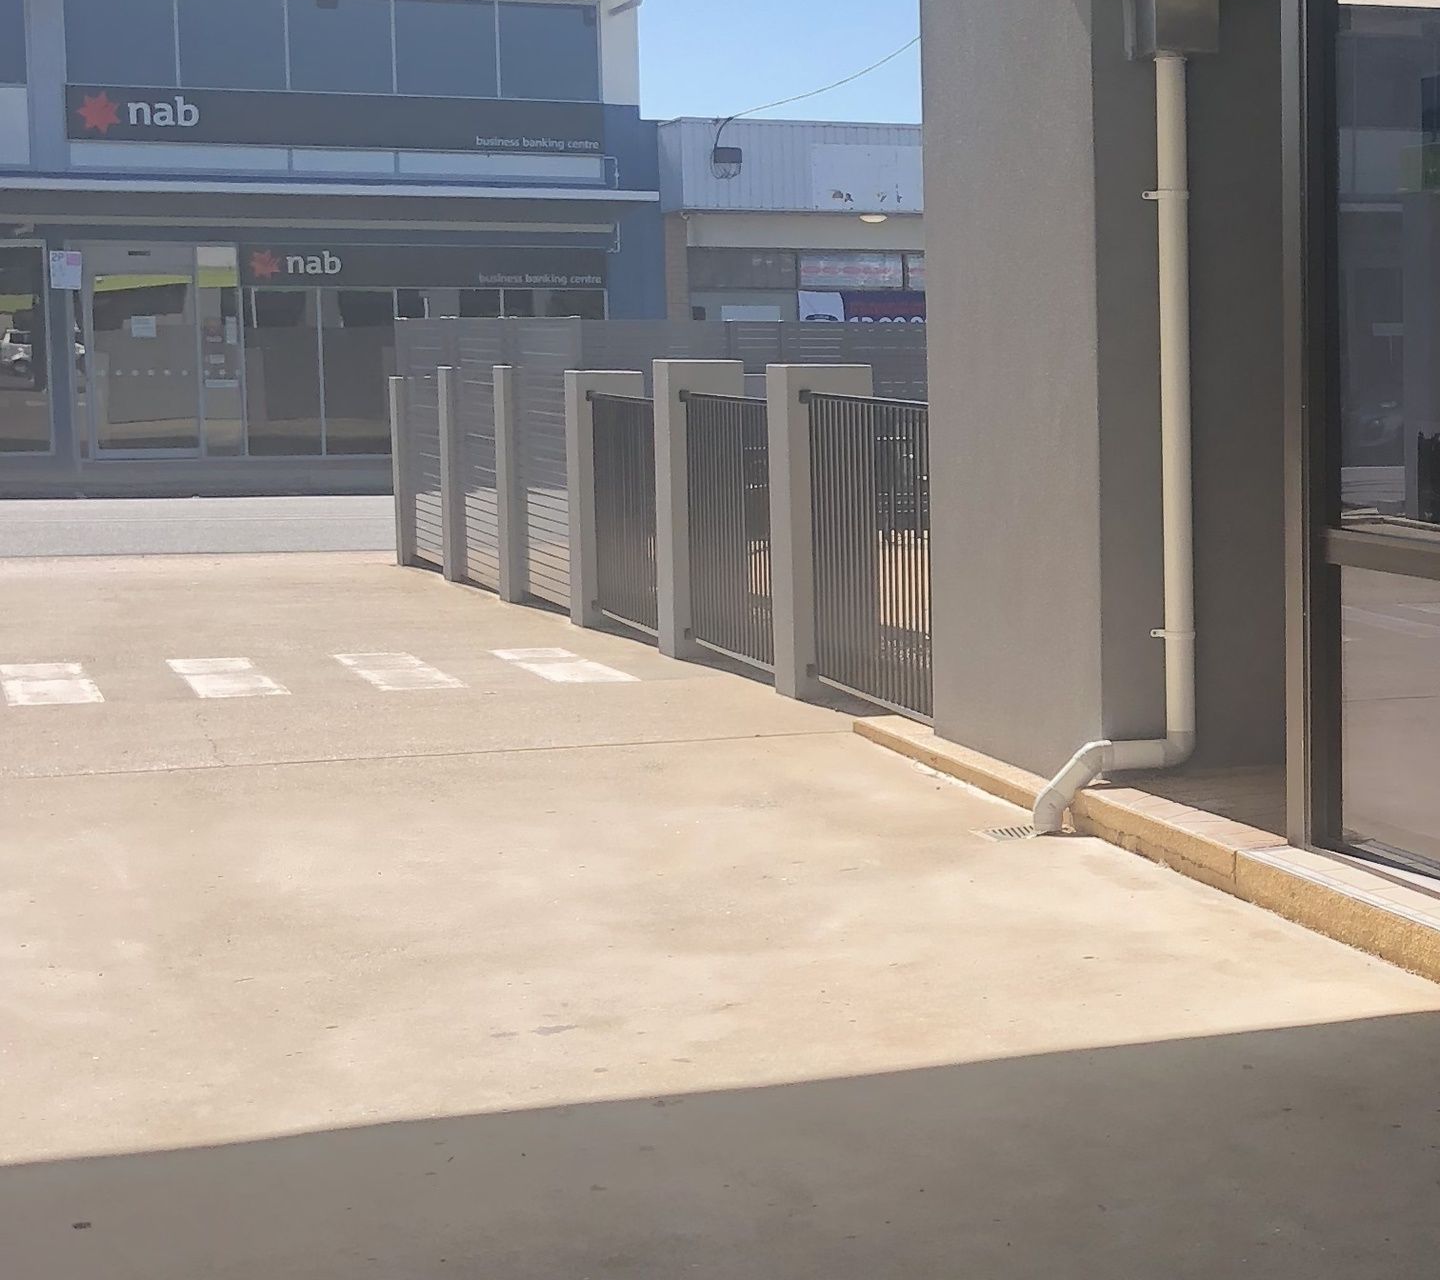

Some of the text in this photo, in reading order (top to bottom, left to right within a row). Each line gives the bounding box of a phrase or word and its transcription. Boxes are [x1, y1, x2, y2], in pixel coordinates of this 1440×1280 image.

[127, 96, 200, 127] nab
[476, 136, 600, 150] business banking centre
[286, 250, 342, 275] nab
[479, 272, 602, 286] business banking centre
